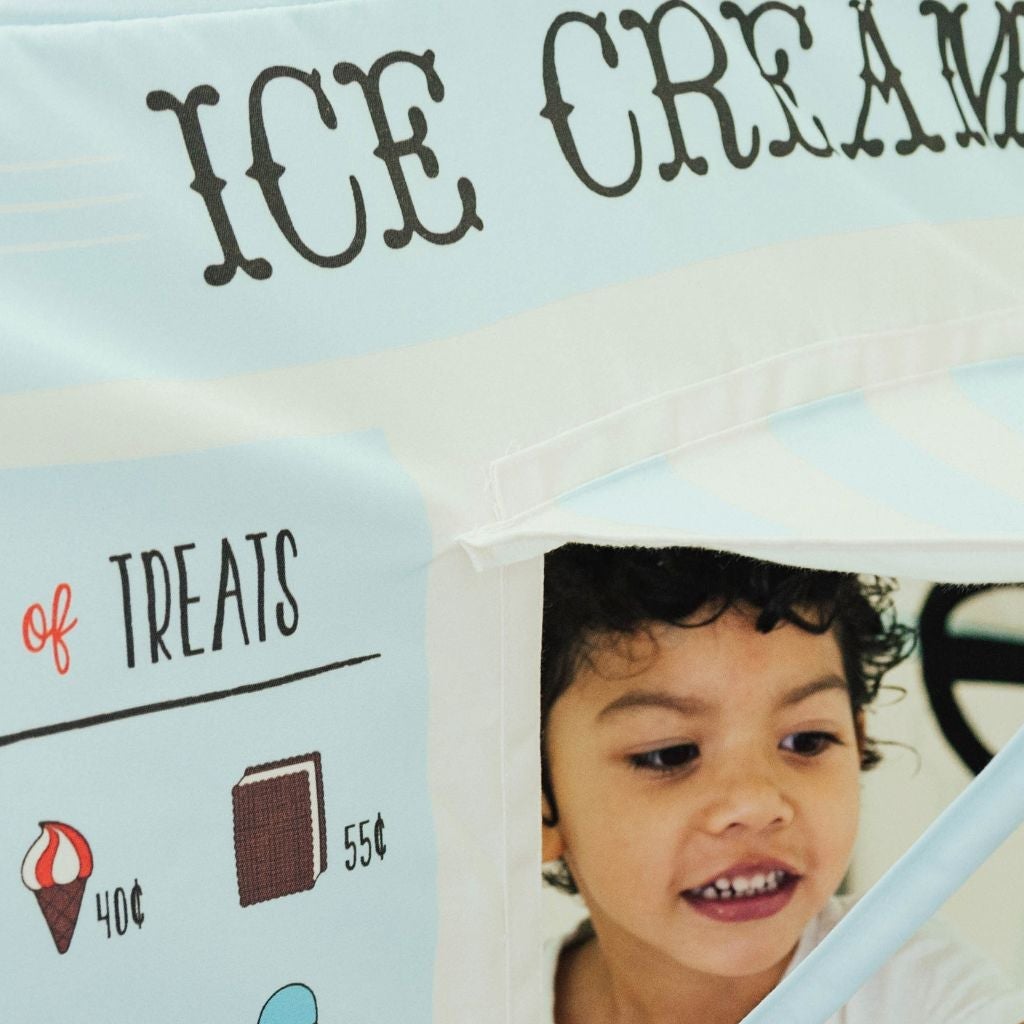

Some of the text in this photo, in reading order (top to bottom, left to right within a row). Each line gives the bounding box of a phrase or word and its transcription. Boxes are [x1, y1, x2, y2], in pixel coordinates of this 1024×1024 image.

[145, 48, 485, 288] ICE
[21, 528, 301, 676] of TREATS
[344, 811, 387, 872] 55¢
[95, 878, 145, 939] 40¢
